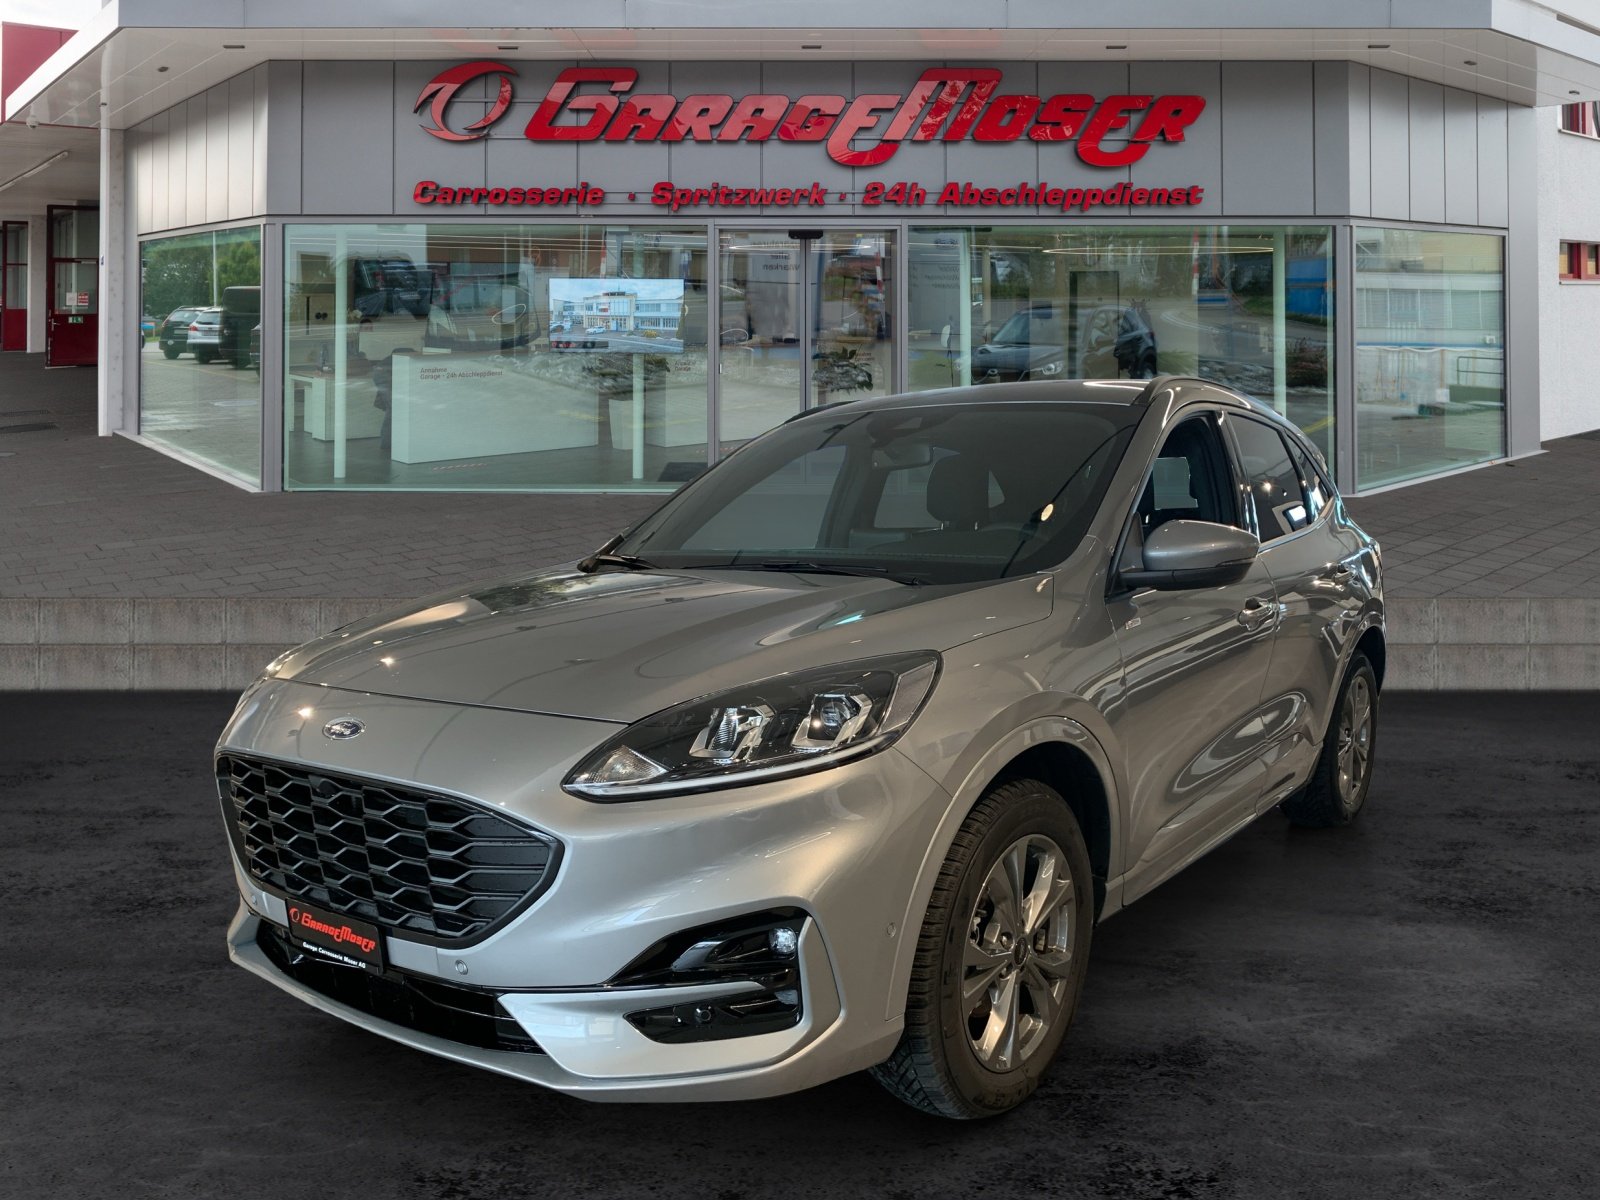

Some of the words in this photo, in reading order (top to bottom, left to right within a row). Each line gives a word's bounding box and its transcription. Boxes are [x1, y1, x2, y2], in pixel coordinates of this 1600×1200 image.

[413, 180, 604, 205] Carrosserie
[650, 182, 826, 210] Spritzwerk
[863, 182, 926, 206] 24h
[936, 182, 1204, 211] Abschleppdienst
[458, 370, 503, 379] Abschleppdienst
